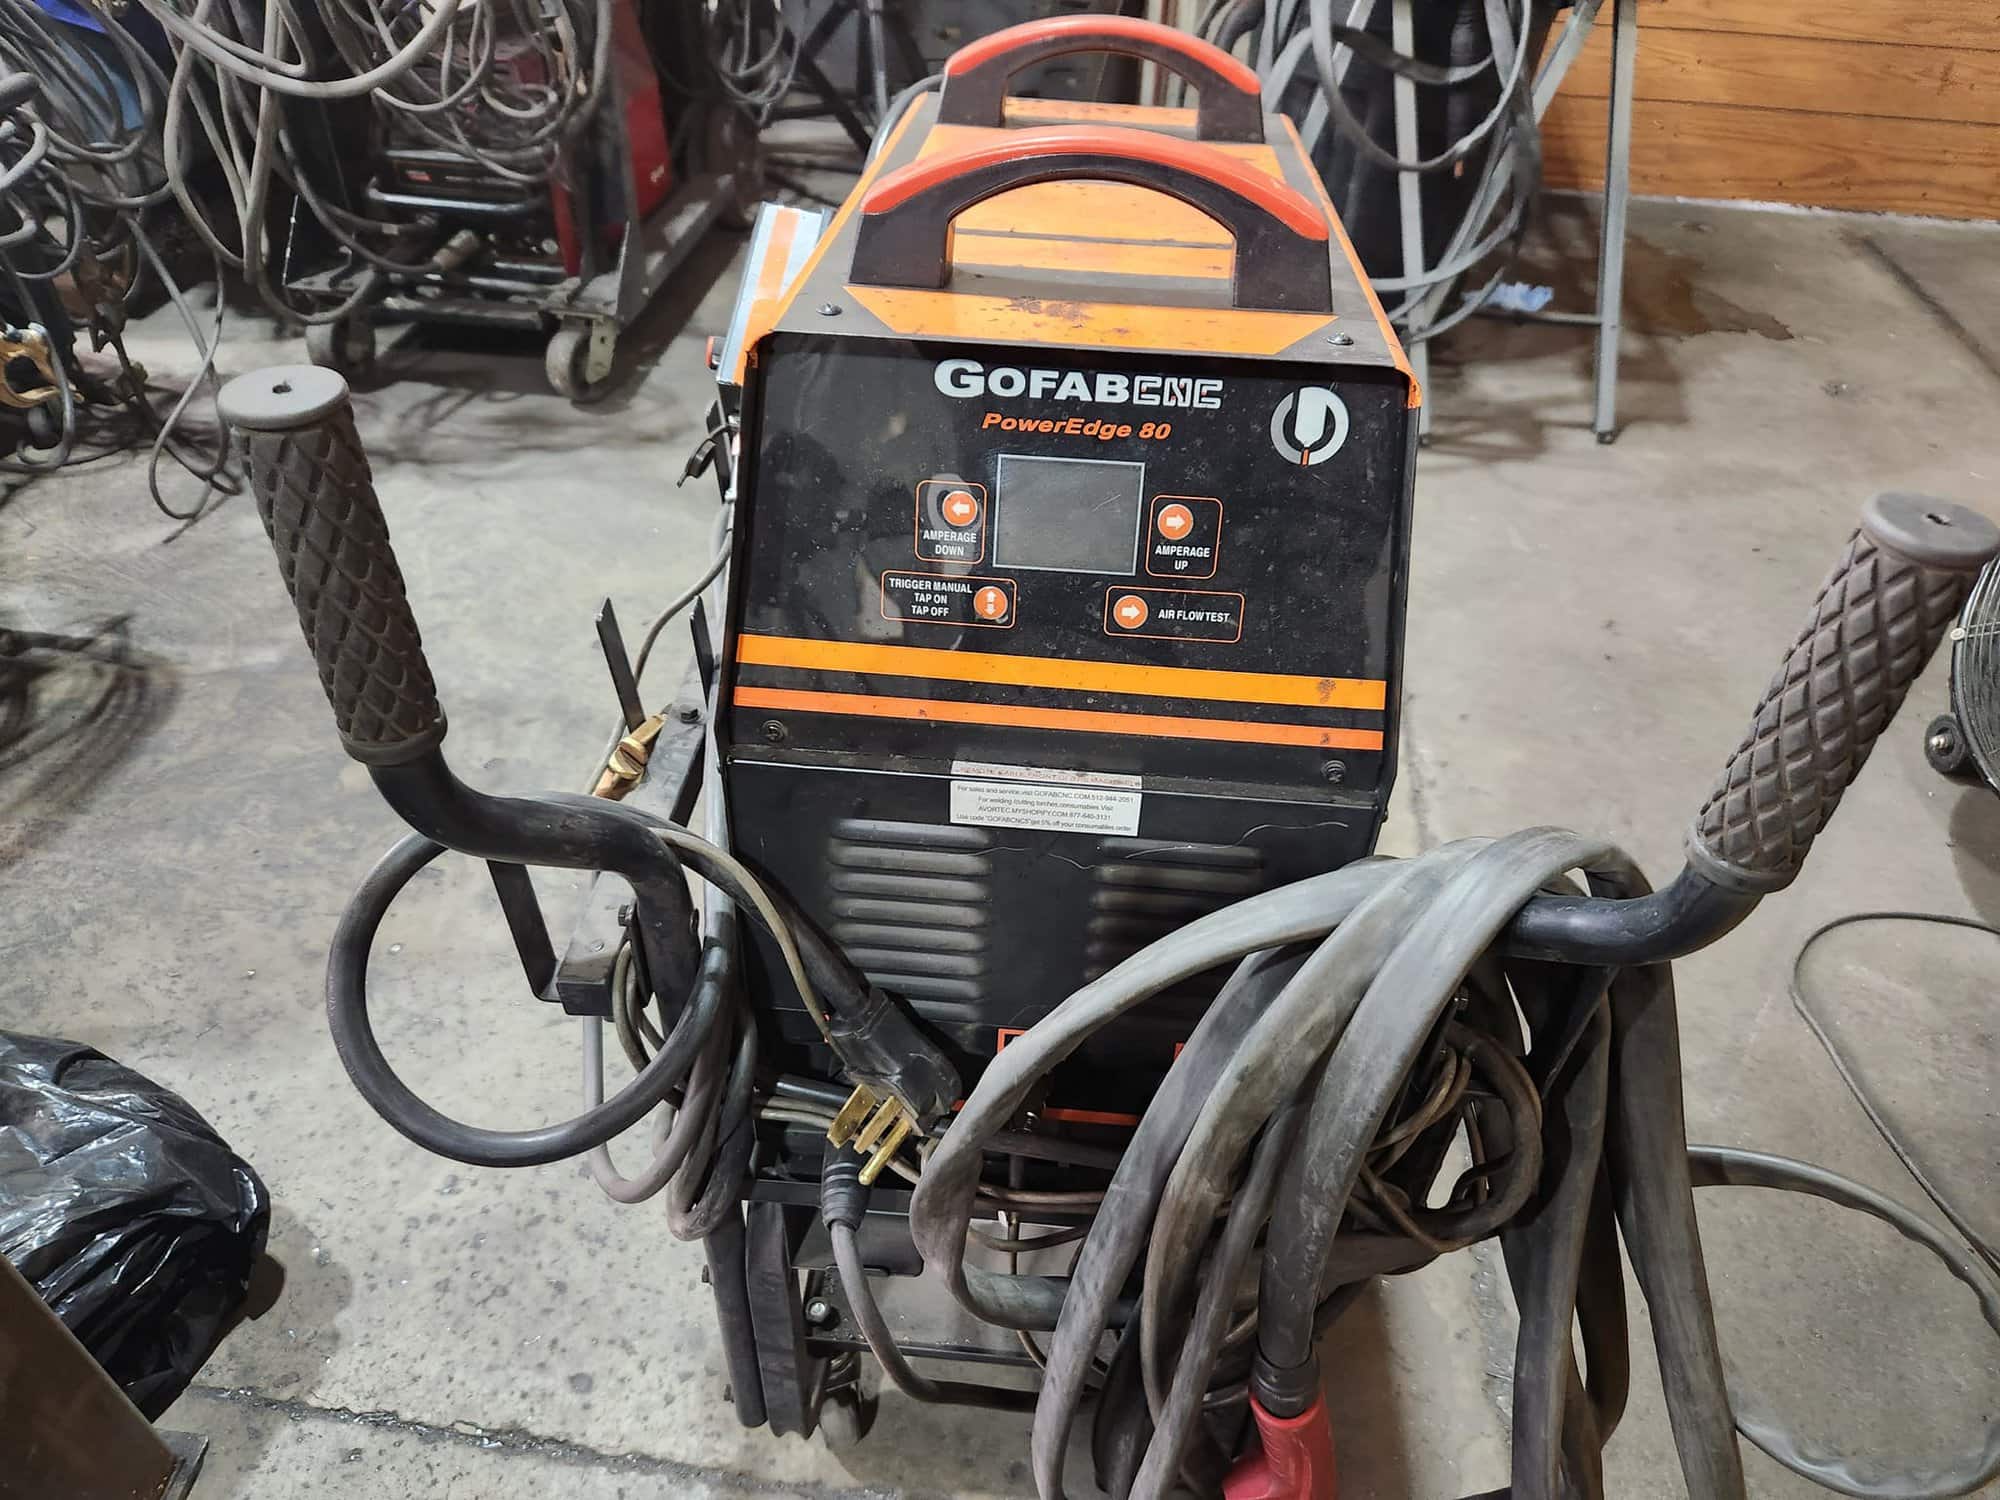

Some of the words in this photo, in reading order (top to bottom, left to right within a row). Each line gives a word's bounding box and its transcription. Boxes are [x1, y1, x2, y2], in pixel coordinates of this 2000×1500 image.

[981, 412, 1132, 441] PowerEdge
[1138, 421, 1172, 440] 80
[922, 529, 977, 543] AMPERAGE
[935, 545, 964, 556] DOWN
[1155, 545, 1211, 558] AMPERAGE
[1174, 560, 1188, 570] UP
[889, 577, 932, 590] TRIGGER
[933, 580, 973, 594] MANUAL
[914, 593, 932, 603] TAP
[933, 594, 947, 604] ON
[911, 605, 930, 615] TAP
[930, 606, 949, 617] OFF
[1158, 609, 1175, 620] AIR
